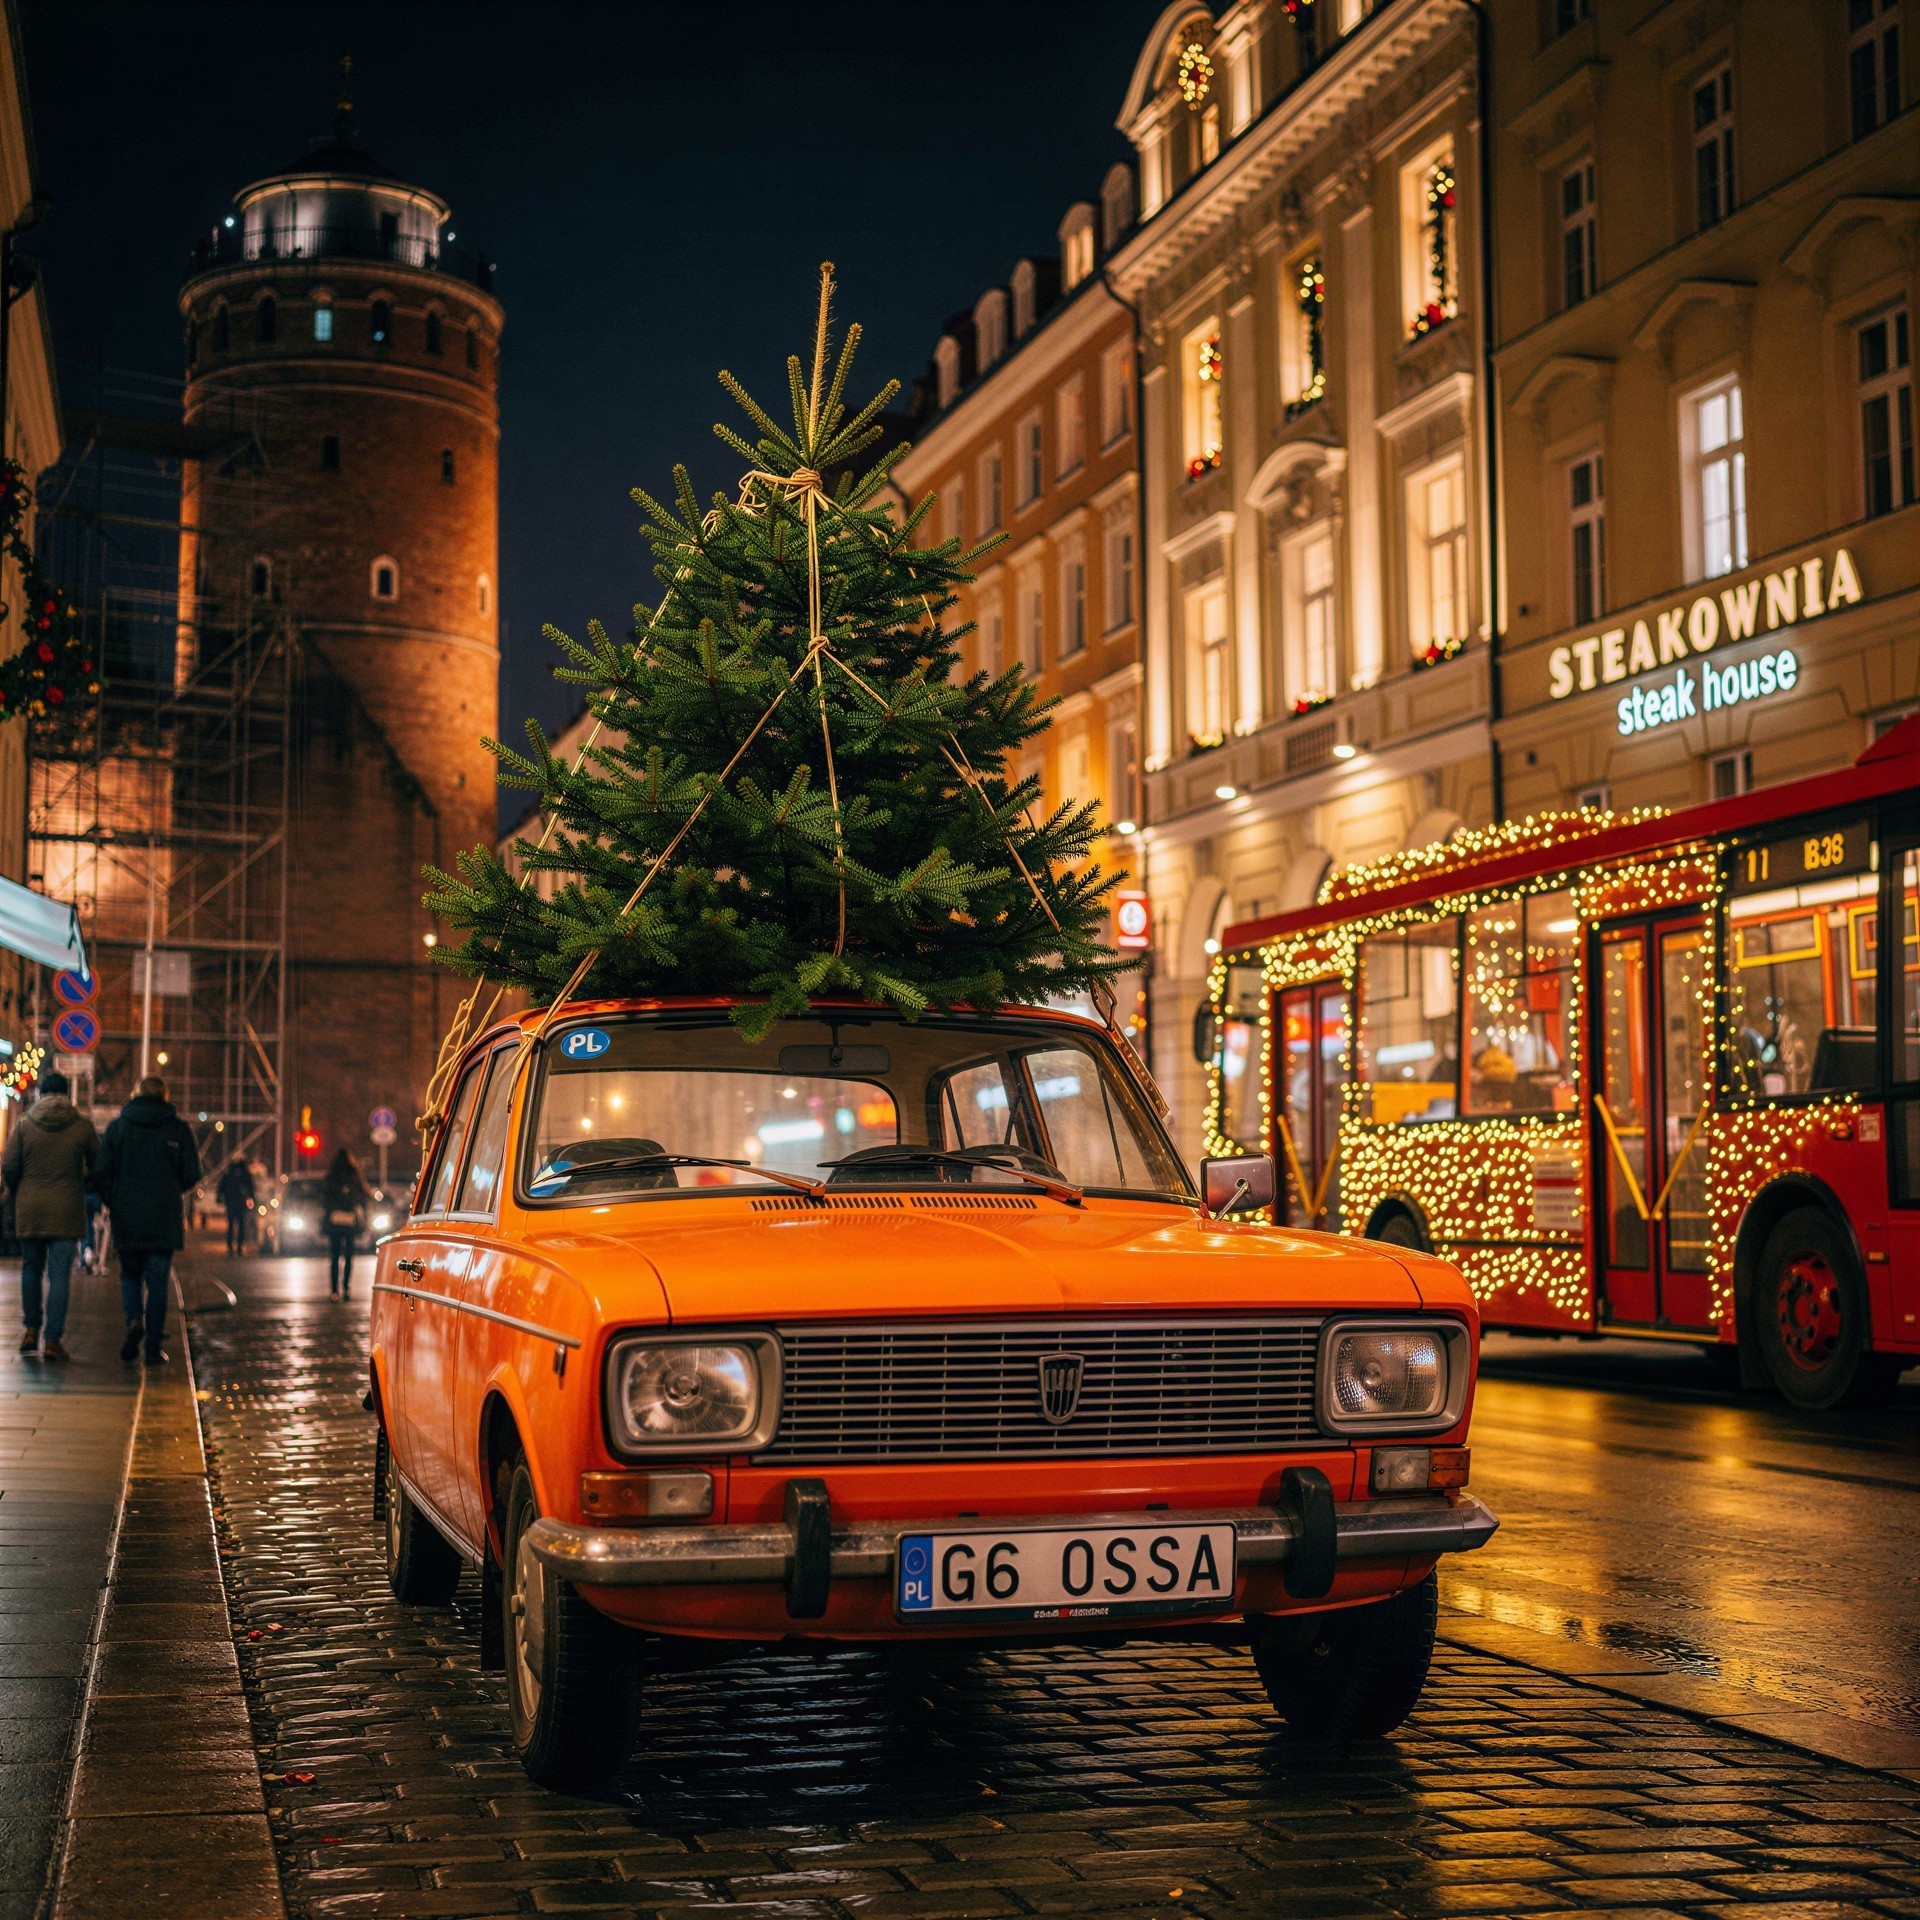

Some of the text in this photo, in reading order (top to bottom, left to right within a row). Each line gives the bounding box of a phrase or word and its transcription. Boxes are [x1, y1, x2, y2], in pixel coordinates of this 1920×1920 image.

[1549, 548, 1864, 699] STEAKOWNIA
[1617, 649, 1798, 736] steak house
[1747, 847, 1769, 882] 11
[568, 1033, 602, 1054] PL
[905, 1580, 929, 1601] PL
[942, 1542, 1020, 1602] G6
